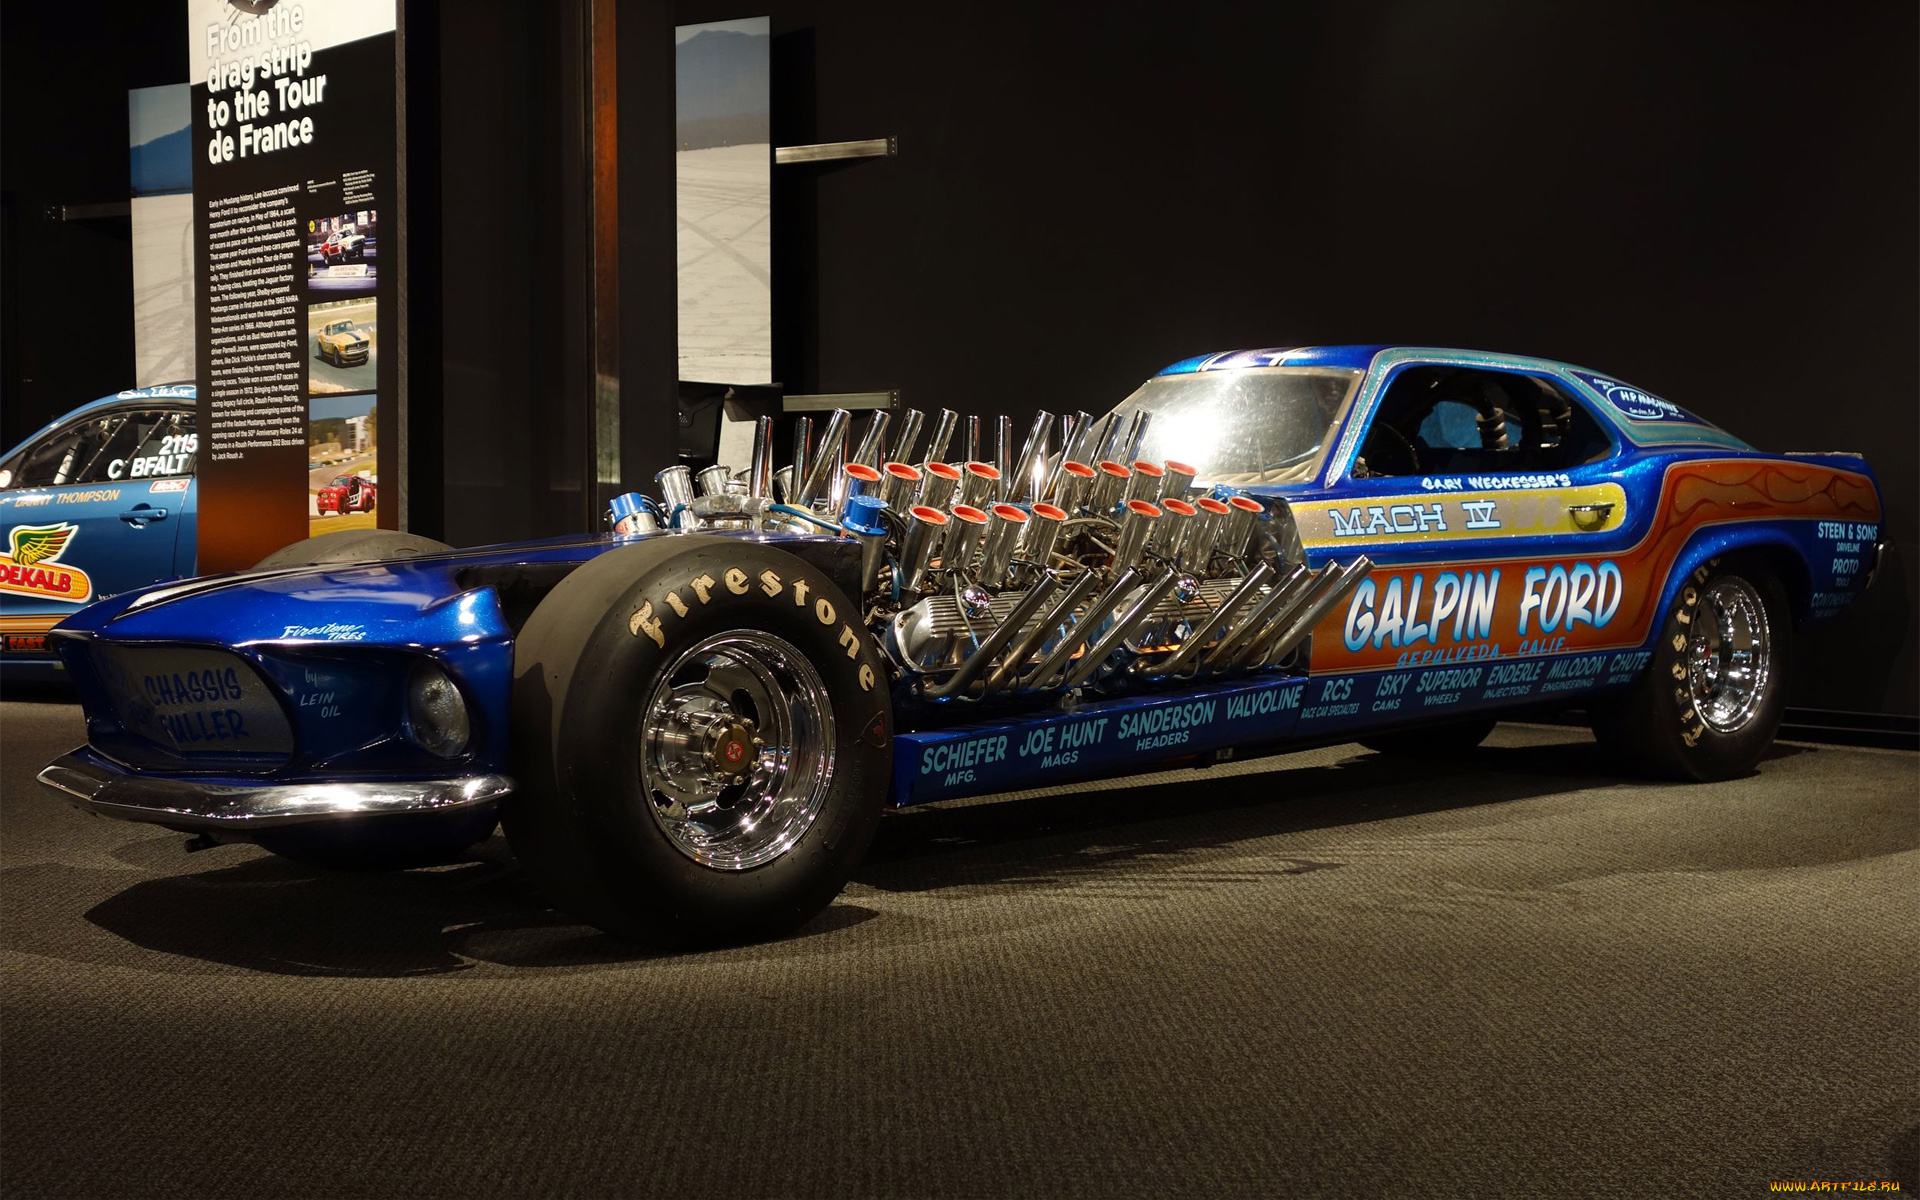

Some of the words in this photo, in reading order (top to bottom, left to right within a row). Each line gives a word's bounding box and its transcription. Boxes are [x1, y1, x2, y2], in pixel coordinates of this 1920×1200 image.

[206, 17, 261, 57] From
[267, 5, 304, 39] the
[207, 56, 255, 93] drag
[260, 37, 312, 79] strip
[207, 98, 230, 129] to
[234, 89, 269, 122] the
[275, 74, 326, 112] Tour
[208, 130, 235, 165] de
[240, 116, 314, 158] France
[229, 250, 238, 258] year
[237, 247, 248, 255] Ford
[247, 245, 263, 254] entered
[280, 238, 300, 250] prepared
[219, 272, 229, 280] They
[228, 269, 244, 278] finished
[244, 268, 252, 276] first
[260, 264, 276, 274] second
[275, 264, 287, 272] place
[228, 291, 247, 300] following
[263, 307, 283, 317] inaugural
[282, 306, 295, 314] SCCA
[254, 319, 274, 328] Although
[210, 347, 222, 355] driver
[259, 340, 281, 350] sponsored
[286, 338, 298, 346] Ford,
[236, 334, 247, 342] such
[223, 356, 231, 364] like
[255, 353, 267, 361] short
[266, 351, 278, 360] track
[223, 399, 236, 407] legacy
[254, 396, 267, 404] Roush
[283, 394, 299, 402] Racing,
[233, 419, 247, 427] fastest
[158, 433, 199, 455] 2115
[211, 442, 227, 450] Daytona
[234, 440, 247, 448] Roush
[1421, 477, 1463, 491] GARY
[1467, 474, 1572, 489] WECKESSER'S
[56, 489, 121, 505] THOMPSON
[1329, 503, 1448, 537] MACH
[1461, 500, 1501, 530] IV
[1818, 522, 1845, 539] STEEN
[1848, 524, 1853, 540] &
[1856, 524, 1878, 540] SONS
[1832, 558, 1859, 574] PROTO
[0, 565, 72, 594] DEKALB
[1343, 567, 1501, 651] GALPIN
[1517, 560, 1623, 636] FORD
[279, 622, 364, 640] Firestone
[327, 630, 367, 641] TIRES
[629, 566, 875, 693] Firestone
[1519, 636, 1571, 656] CALIF.
[143, 667, 243, 705] CHASSIS
[1482, 684, 1532, 699] INJECTORS
[1540, 677, 1594, 693] ENGINEERING
[1371, 698, 1402, 712] CAMS
[1423, 692, 1461, 706] WHEELS
[321, 707, 341, 718] OIL
[920, 735, 1008, 775] SCHIEFER
[1019, 727, 1054, 757] JOE
[1059, 718, 1109, 751] HUNT
[1117, 701, 1216, 741] SANDERSON
[1226, 685, 1304, 720] VALVOLINE
[1321, 678, 1354, 702] RCS
[1375, 673, 1412, 697] ISKY
[1416, 667, 1482, 693] SUPERIOR
[1486, 661, 1541, 685] ENDERLE
[1549, 655, 1604, 680] MILODON
[1609, 651, 1651, 673] CHUTE
[1316, 705, 1328, 718] CAR
[1136, 731, 1190, 752] HEADERS
[1040, 750, 1079, 770] MAGS
[944, 769, 977, 787] MFG.
